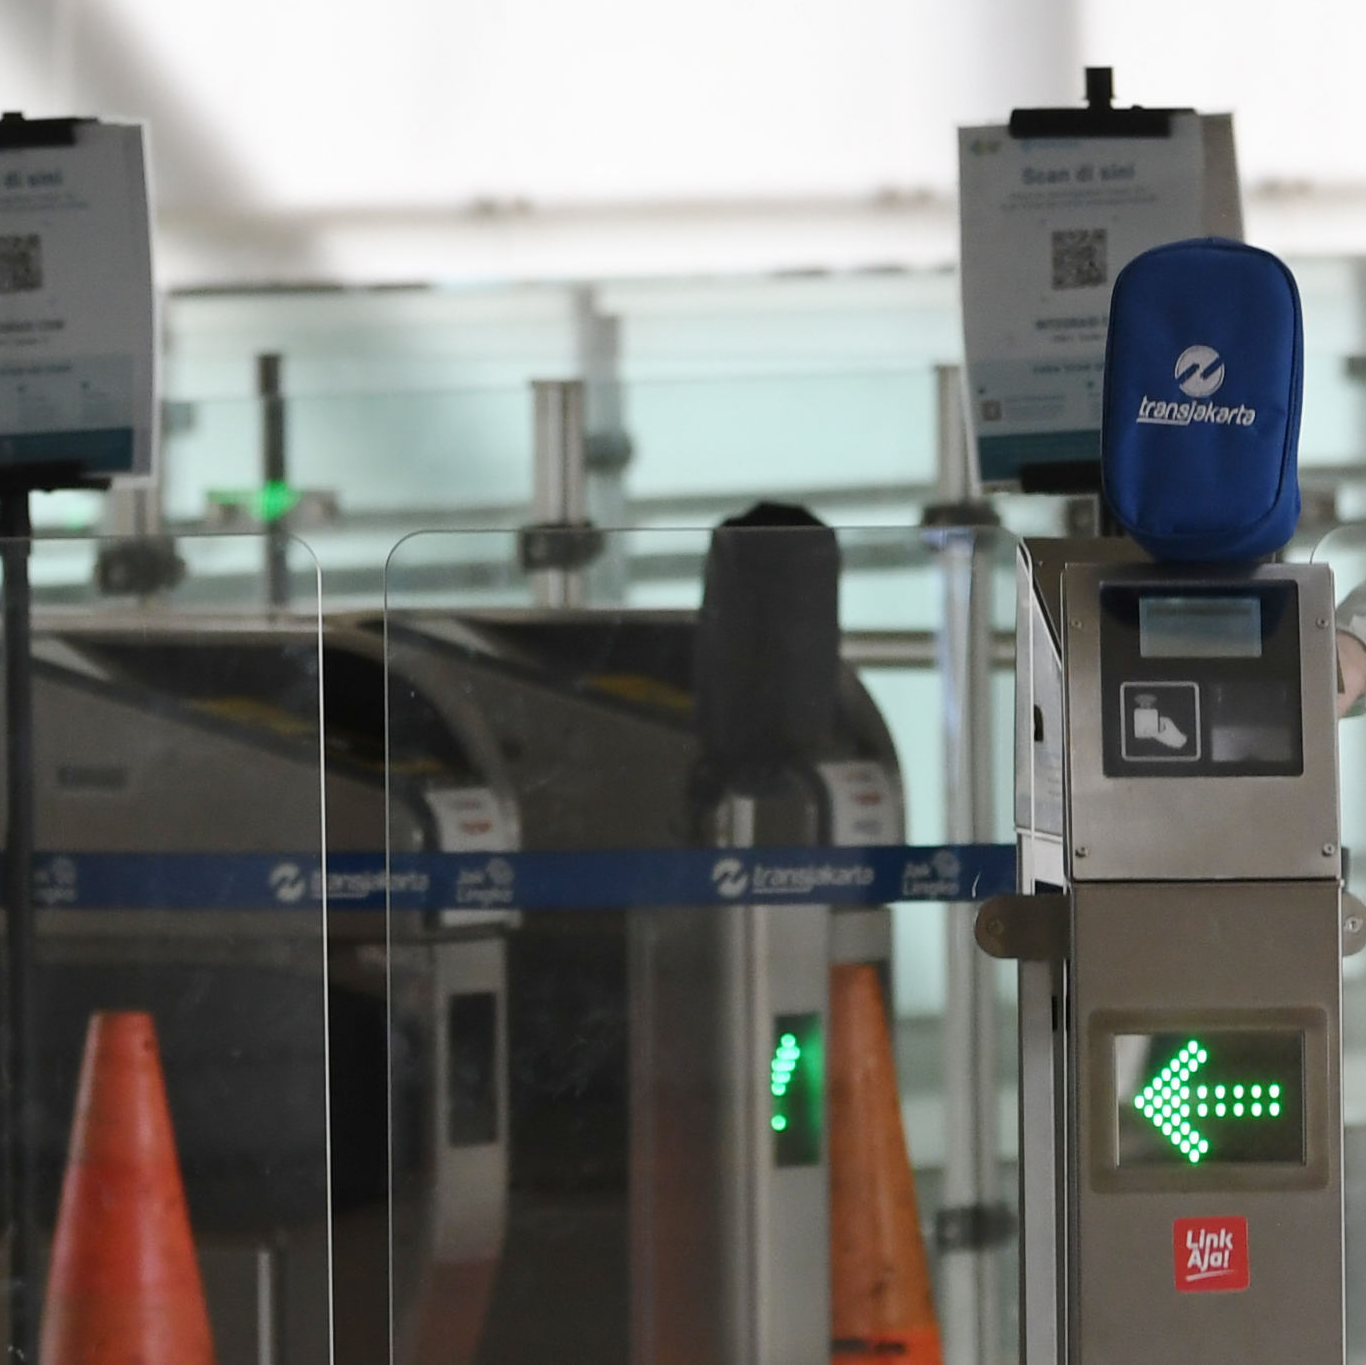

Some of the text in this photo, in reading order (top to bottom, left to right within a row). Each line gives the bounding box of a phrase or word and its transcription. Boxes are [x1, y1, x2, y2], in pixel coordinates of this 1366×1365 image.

[28, 168, 63, 186] sini
[1021, 166, 1070, 185] Scan
[1099, 162, 1136, 181] sini
[1136, 394, 1256, 426] transjakarta
[1186, 1228, 1233, 1250] Link
